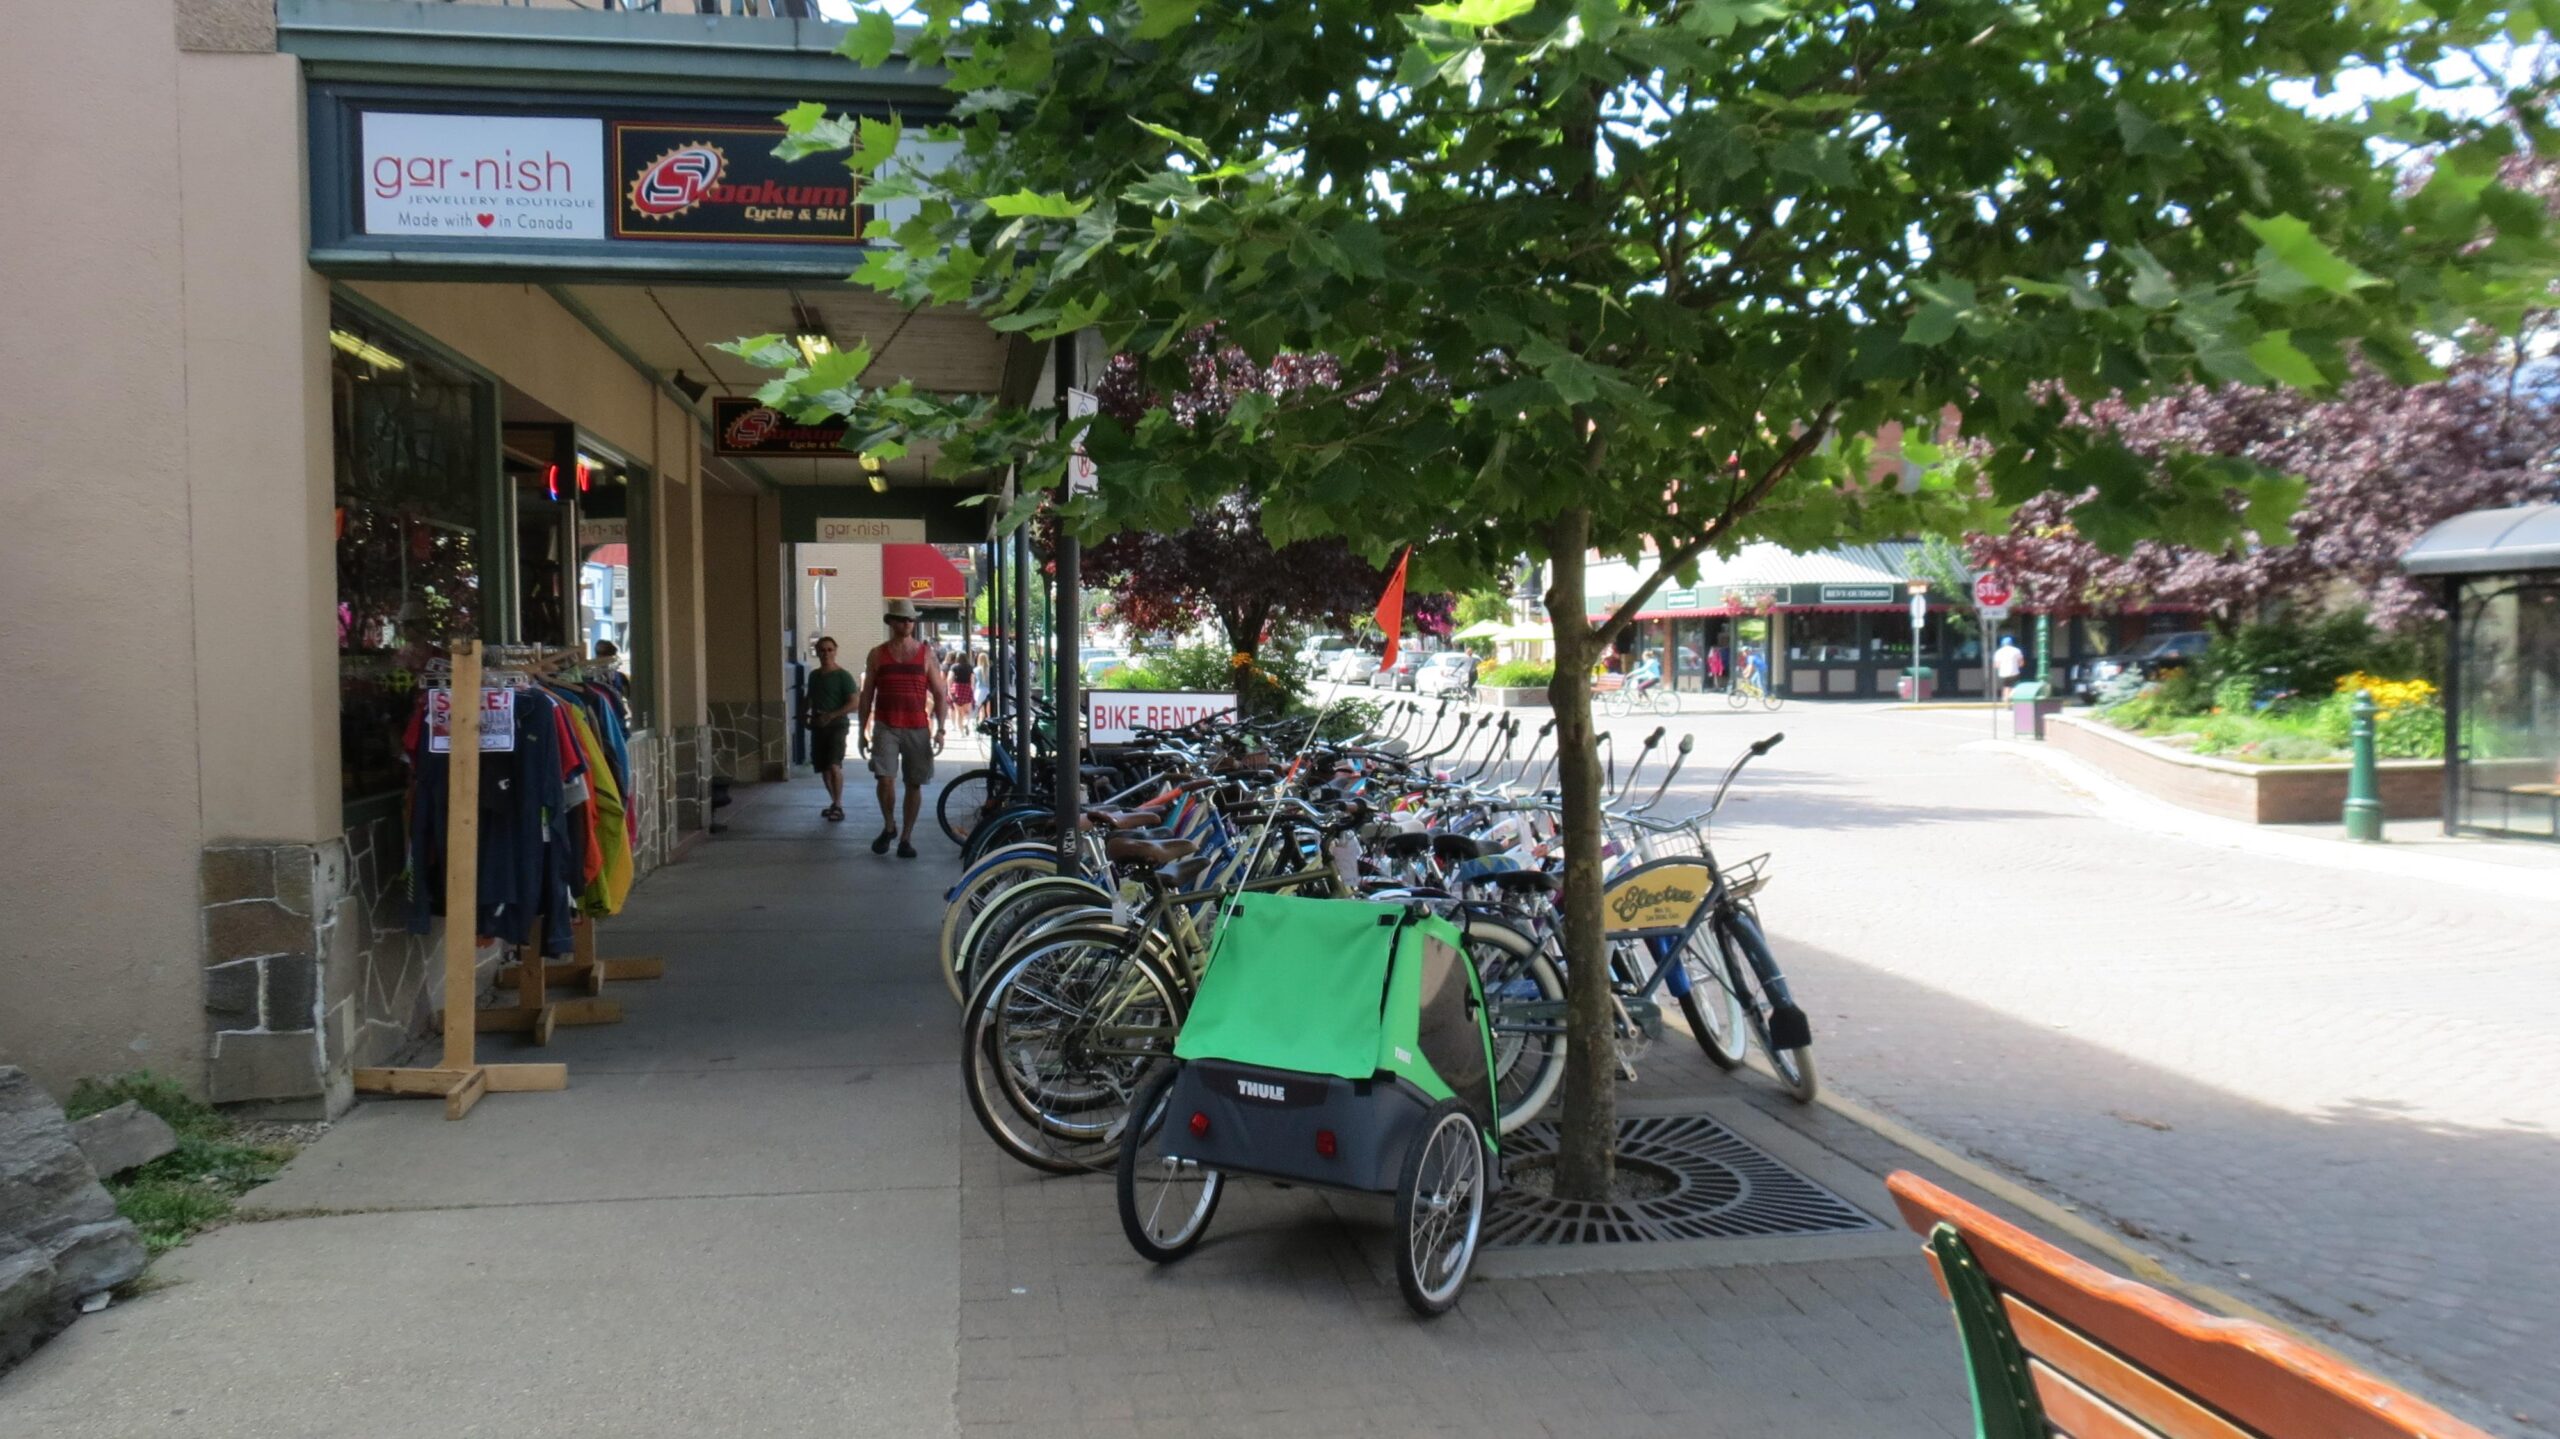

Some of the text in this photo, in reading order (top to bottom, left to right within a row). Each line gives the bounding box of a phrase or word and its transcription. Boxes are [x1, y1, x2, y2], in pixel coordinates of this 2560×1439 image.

[408, 195, 595, 209] JEWELLERY BOUTIQUE
[399, 211, 573, 231] Made with in Canada
[744, 206, 846, 222] Cycle & Ski
[911, 579, 930, 589] CIBC
[436, 692, 509, 711] SE!
[1094, 705, 1140, 730] BIKE
[1612, 885, 1696, 922] Electra
[1237, 1079, 1285, 1101] THULE
